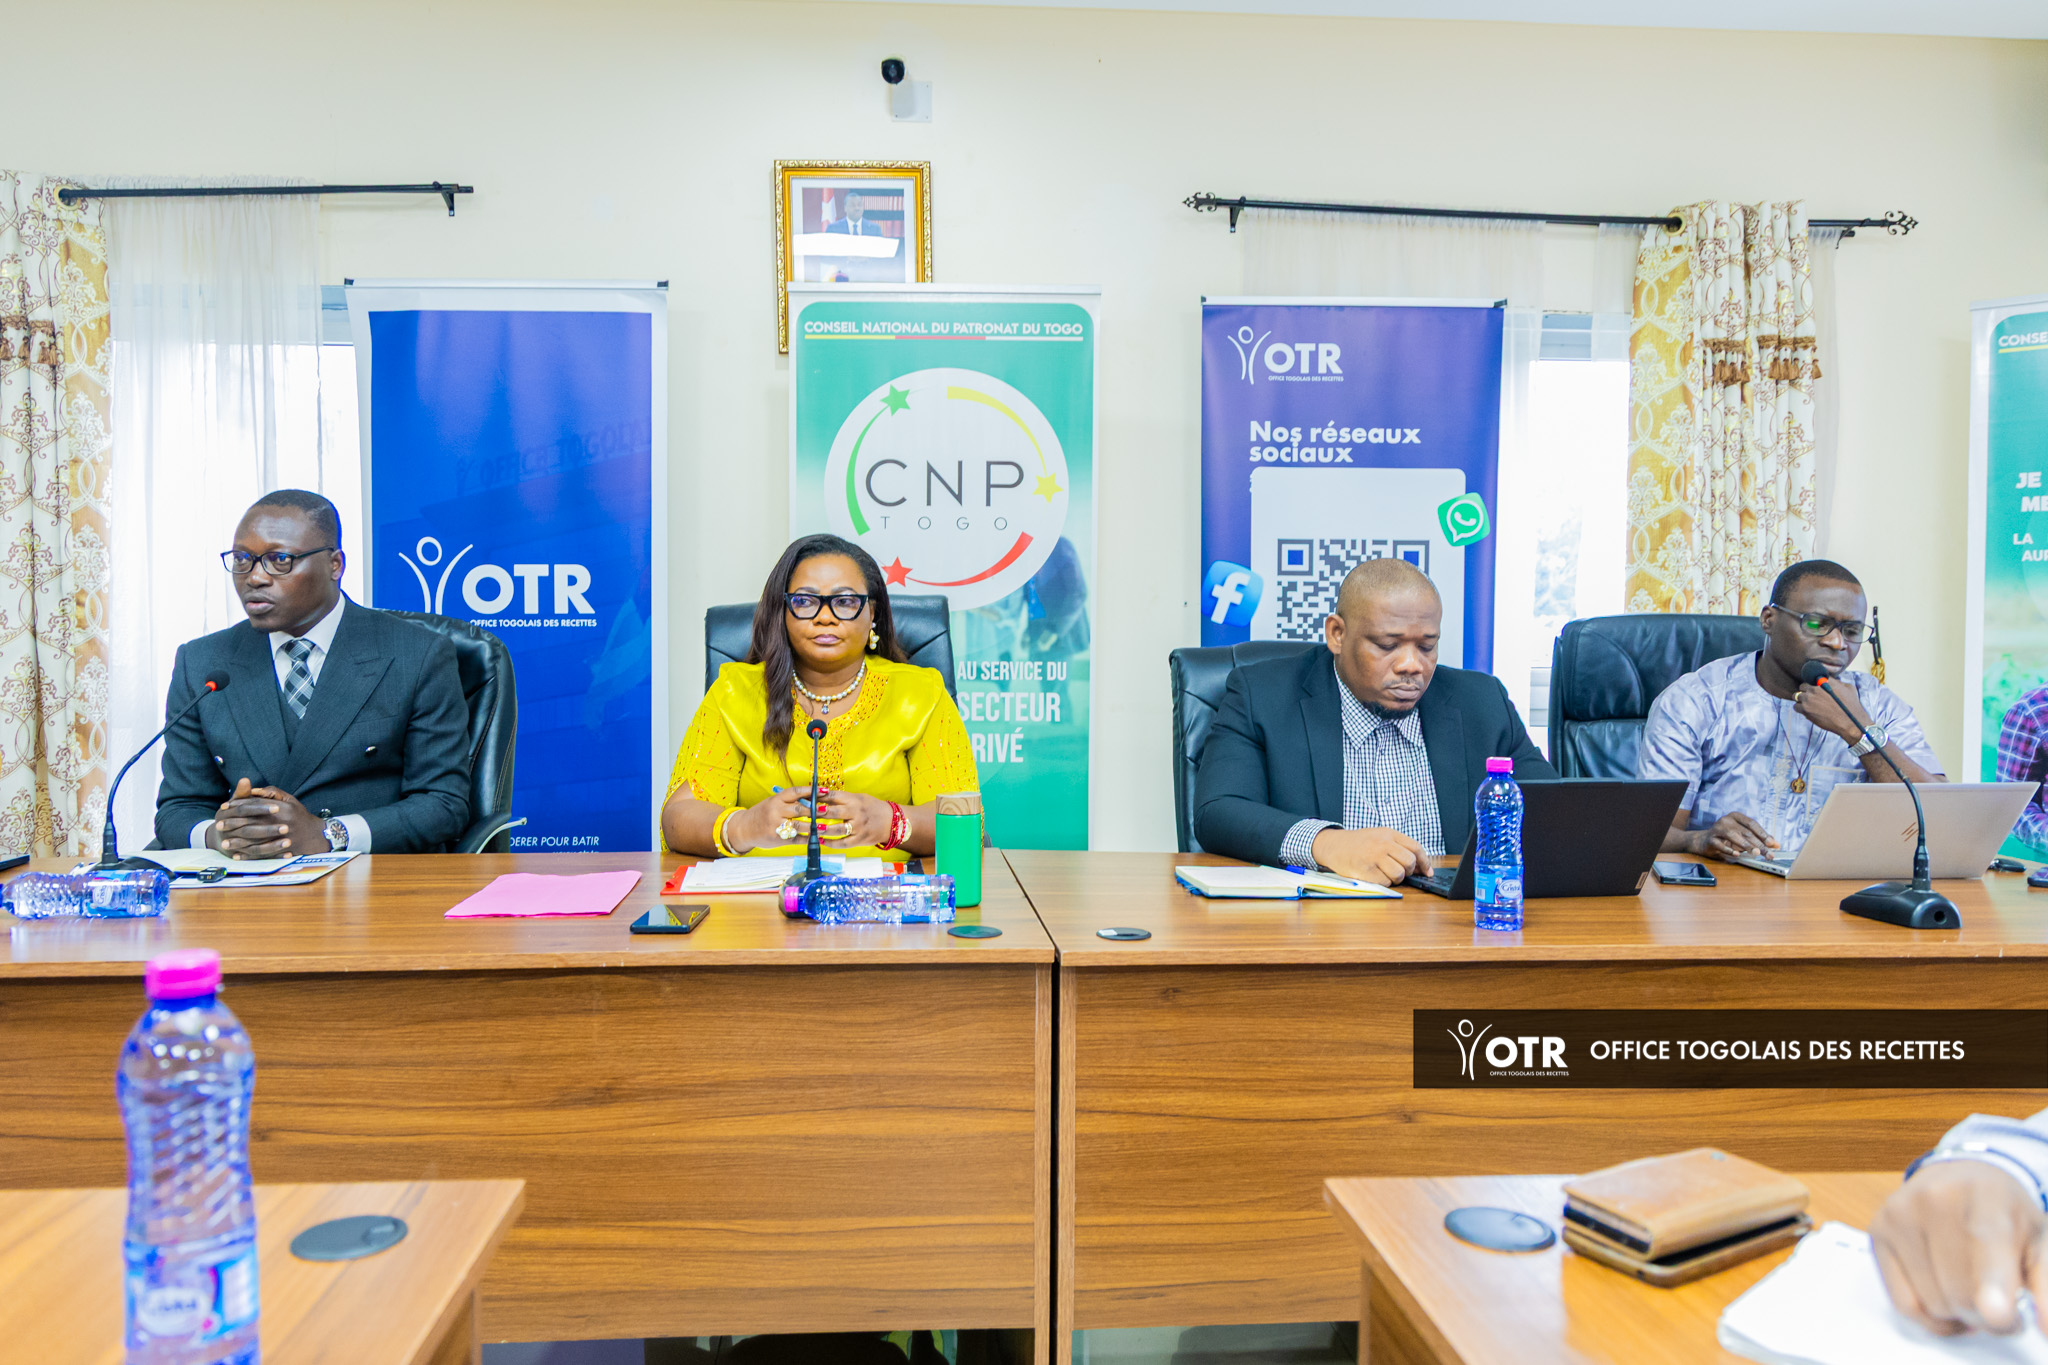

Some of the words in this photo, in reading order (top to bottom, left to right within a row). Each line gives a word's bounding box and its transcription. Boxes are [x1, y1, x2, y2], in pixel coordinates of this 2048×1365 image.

[804, 321, 859, 333] CONSEIL
[862, 322, 928, 334] NATIONAL
[931, 323, 950, 334] DU
[953, 323, 1019, 334] PATRONAT
[1022, 323, 1041, 335] DU
[1044, 323, 1083, 335] TOGO
[1264, 342, 1343, 374] OTR
[1250, 420, 1303, 443] Nos
[1310, 420, 1422, 444] réseaux
[1249, 441, 1354, 463] sociaux
[865, 458, 1024, 507] CNP
[2015, 472, 2042, 489] JE
[880, 516, 1008, 530] TOGO
[2013, 533, 2034, 545] LA
[462, 564, 596, 615] OTR
[470, 619, 498, 627] OFFICE
[499, 619, 542, 628] TOGOLAIS
[543, 619, 559, 628] DES
[560, 619, 598, 628] RECETTES
[957, 661, 977, 681] AU
[980, 661, 1043, 681] SERVICE
[1046, 661, 1067, 681] DU
[957, 692, 1061, 722] SECTEUR
[971, 727, 1024, 763] RIVÉ
[510, 836, 538, 847] DERER
[540, 836, 570, 847] POUR
[572, 836, 600, 846] BATIR
